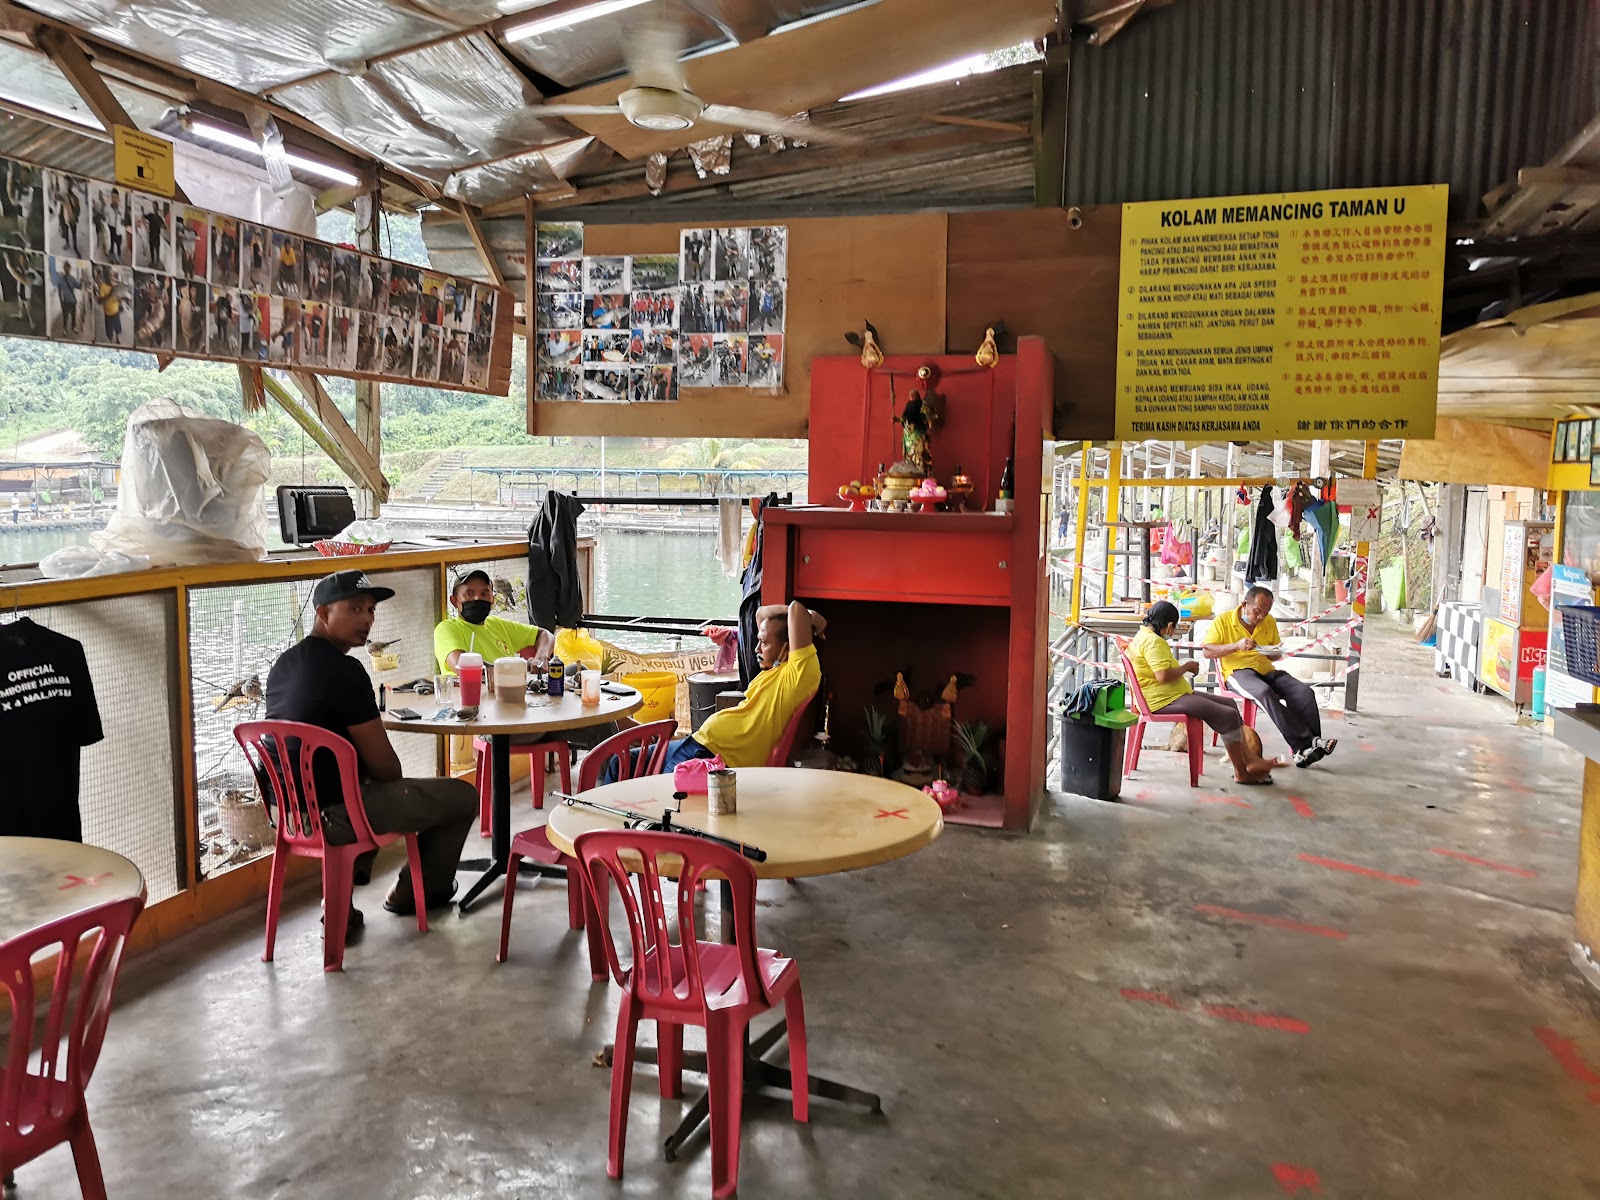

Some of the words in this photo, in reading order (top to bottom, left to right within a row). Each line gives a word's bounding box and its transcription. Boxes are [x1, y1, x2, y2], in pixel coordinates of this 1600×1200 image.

[1161, 208, 1216, 227] KOLAM
[1222, 202, 1323, 223] MEMANCING
[1329, 199, 1387, 218] TAMAN
[1394, 198, 1405, 214] U
[1202, 233, 1236, 242] MEMERIKSA
[1239, 232, 1260, 240] SETIAP
[1263, 231, 1279, 239] TONG
[1141, 247, 1165, 255] PANCING
[1167, 246, 1181, 254] ATAU
[1197, 244, 1221, 252] PANCING
[1224, 243, 1237, 251] BAGI
[1240, 242, 1278, 250] MEMASTIKAN
[1141, 258, 1159, 266] TIADA
[1163, 256, 1199, 265] PEMANCING
[1203, 254, 1235, 262] MEMBAWA
[1239, 253, 1256, 261] ANAK
[1140, 268, 1160, 276] HARAP
[1163, 266, 1197, 274] PEMANCING
[1200, 265, 1219, 273] DAPAT
[1222, 264, 1235, 272] BERI
[1139, 285, 1170, 293] DILARANG
[1173, 283, 1222, 292] MENGGUNAKAN
[1254, 280, 1276, 288] SPESIS
[1140, 295, 1155, 303] ANAK
[1209, 292, 1223, 300] MATI
[1226, 291, 1251, 299] SEBAGAI
[1138, 312, 1168, 320] DILARANG
[1171, 311, 1218, 319] MENGGUNAKAN
[1221, 310, 1242, 318] ORGAN
[1245, 308, 1275, 316] DALAMAN
[1163, 321, 1188, 329] SEPERTI
[1262, 318, 1274, 326] DAN
[1168, 348, 1212, 356] MENGGUNAKAN
[1235, 346, 1251, 354] JENIS
[1235, 356, 1272, 364] BERTINGKAT
[1136, 385, 1167, 393] DILARANG
[1170, 384, 1205, 392] MEMBUANG
[1209, 384, 1222, 392] SISA
[1136, 395, 1157, 403] KEPALA
[1219, 393, 1247, 401] KEDALAM
[1149, 404, 1175, 412] GUNAKAN
[1178, 404, 1192, 412] TONG
[1194, 404, 1216, 412] SAMPAH
[1132, 422, 1155, 432] TERIMA
[1157, 421, 1175, 432] KASIH
[1178, 421, 1200, 431] DIATAS
[1202, 421, 1241, 431] KERJASAMA
[1243, 420, 1260, 430] ANDA
[1297, 419, 1408, 430] 謝謝你們的合作
[8, 664, 55, 682] OFFICIAL
